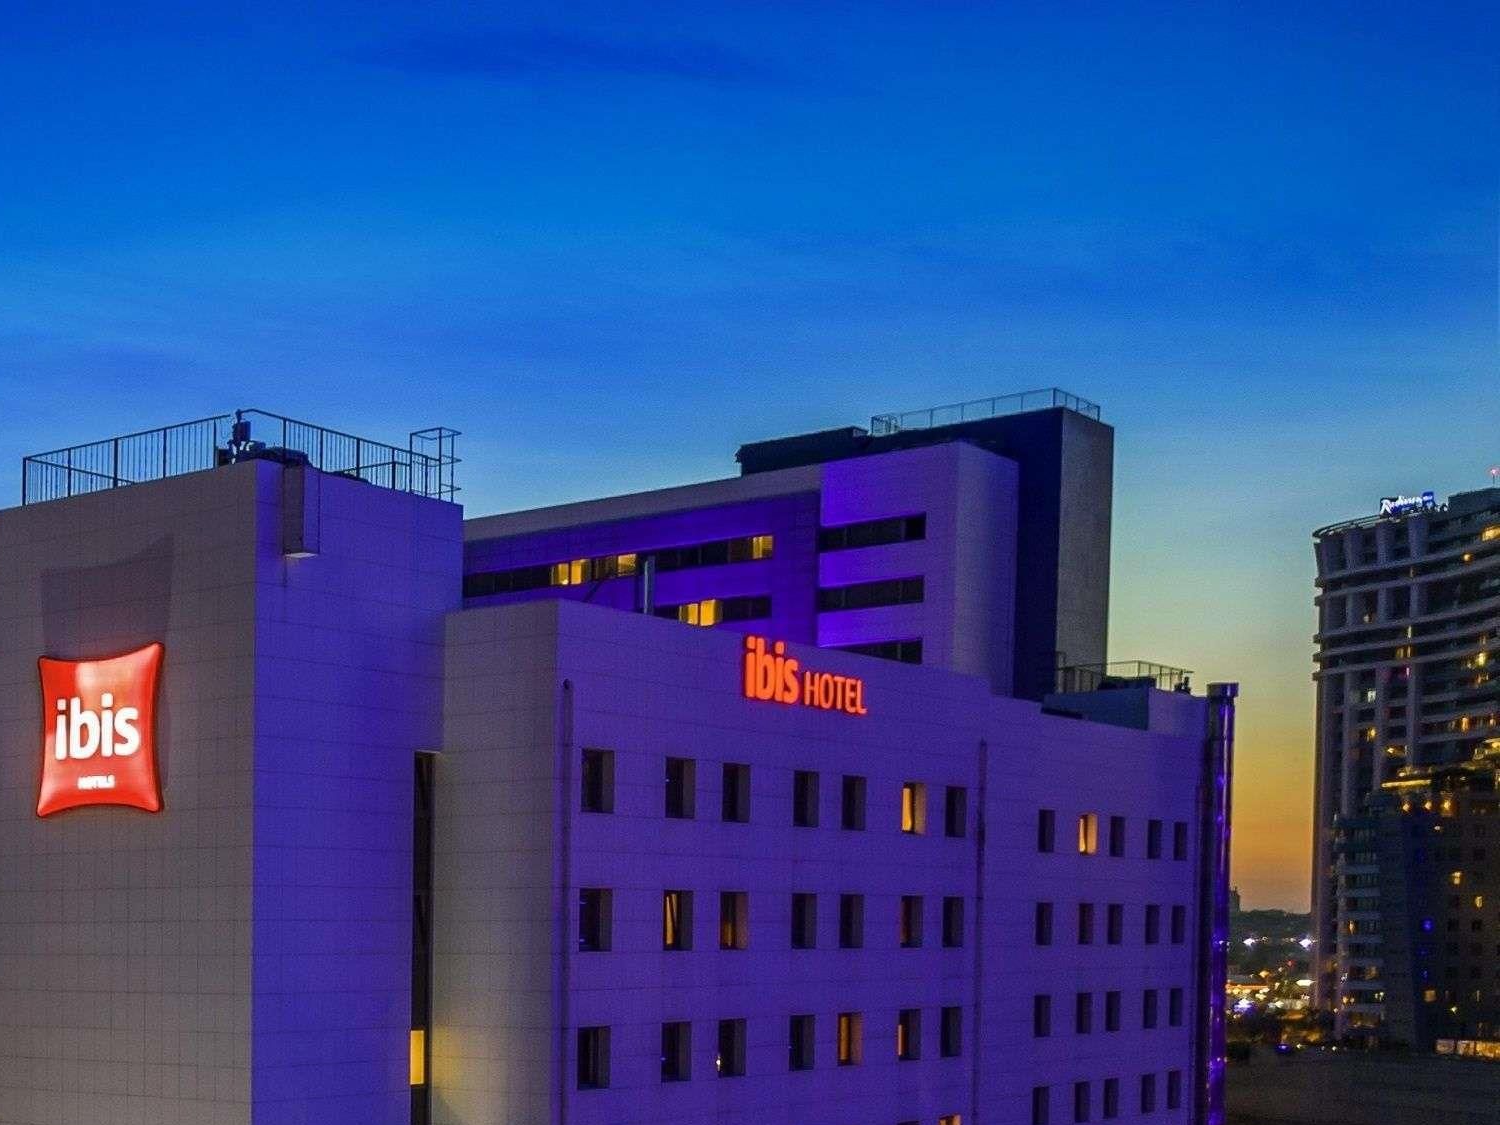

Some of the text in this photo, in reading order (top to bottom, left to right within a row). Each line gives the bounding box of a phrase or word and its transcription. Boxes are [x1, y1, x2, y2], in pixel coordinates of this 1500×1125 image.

[745, 636, 868, 714] ibis HOTEL
[55, 692, 141, 761] ibis
